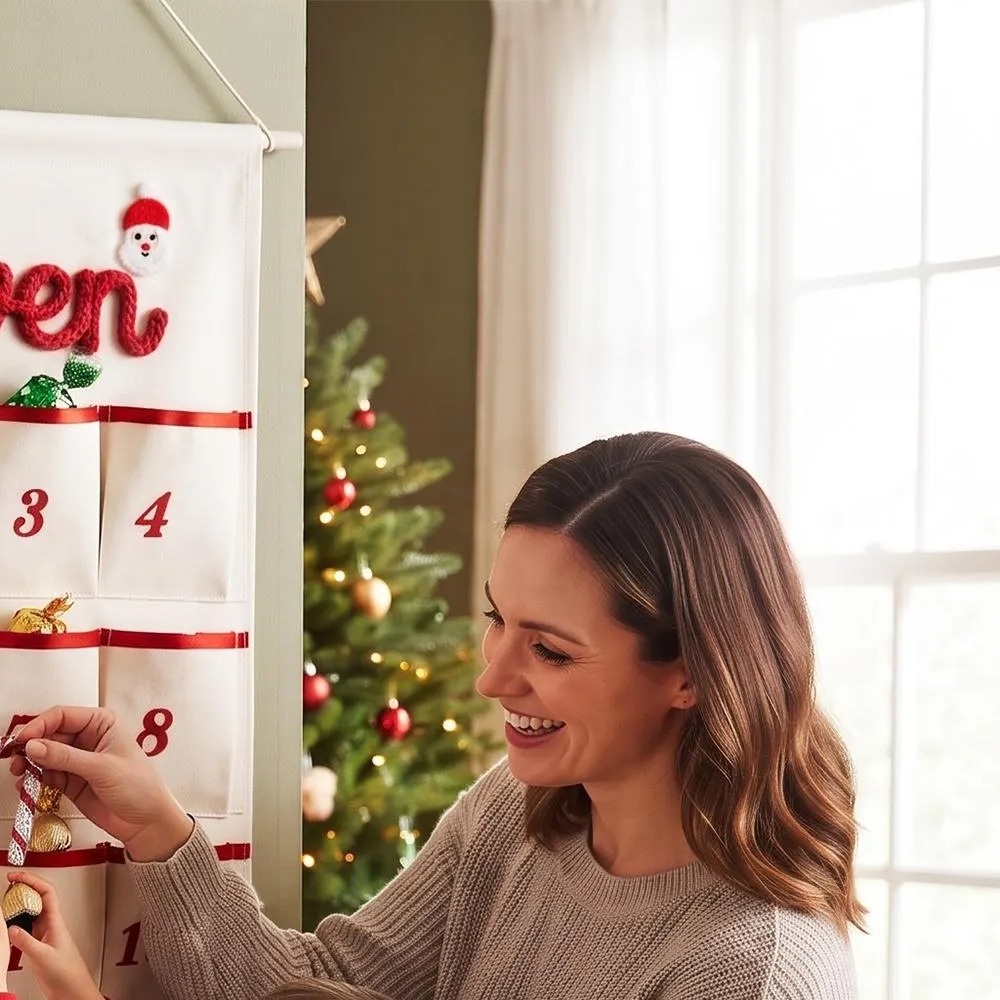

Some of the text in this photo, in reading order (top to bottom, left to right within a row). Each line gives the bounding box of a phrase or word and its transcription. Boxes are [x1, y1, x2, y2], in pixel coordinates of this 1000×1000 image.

[13, 489, 49, 537] 3
[135, 492, 172, 537] 4
[136, 708, 174, 757] 8
